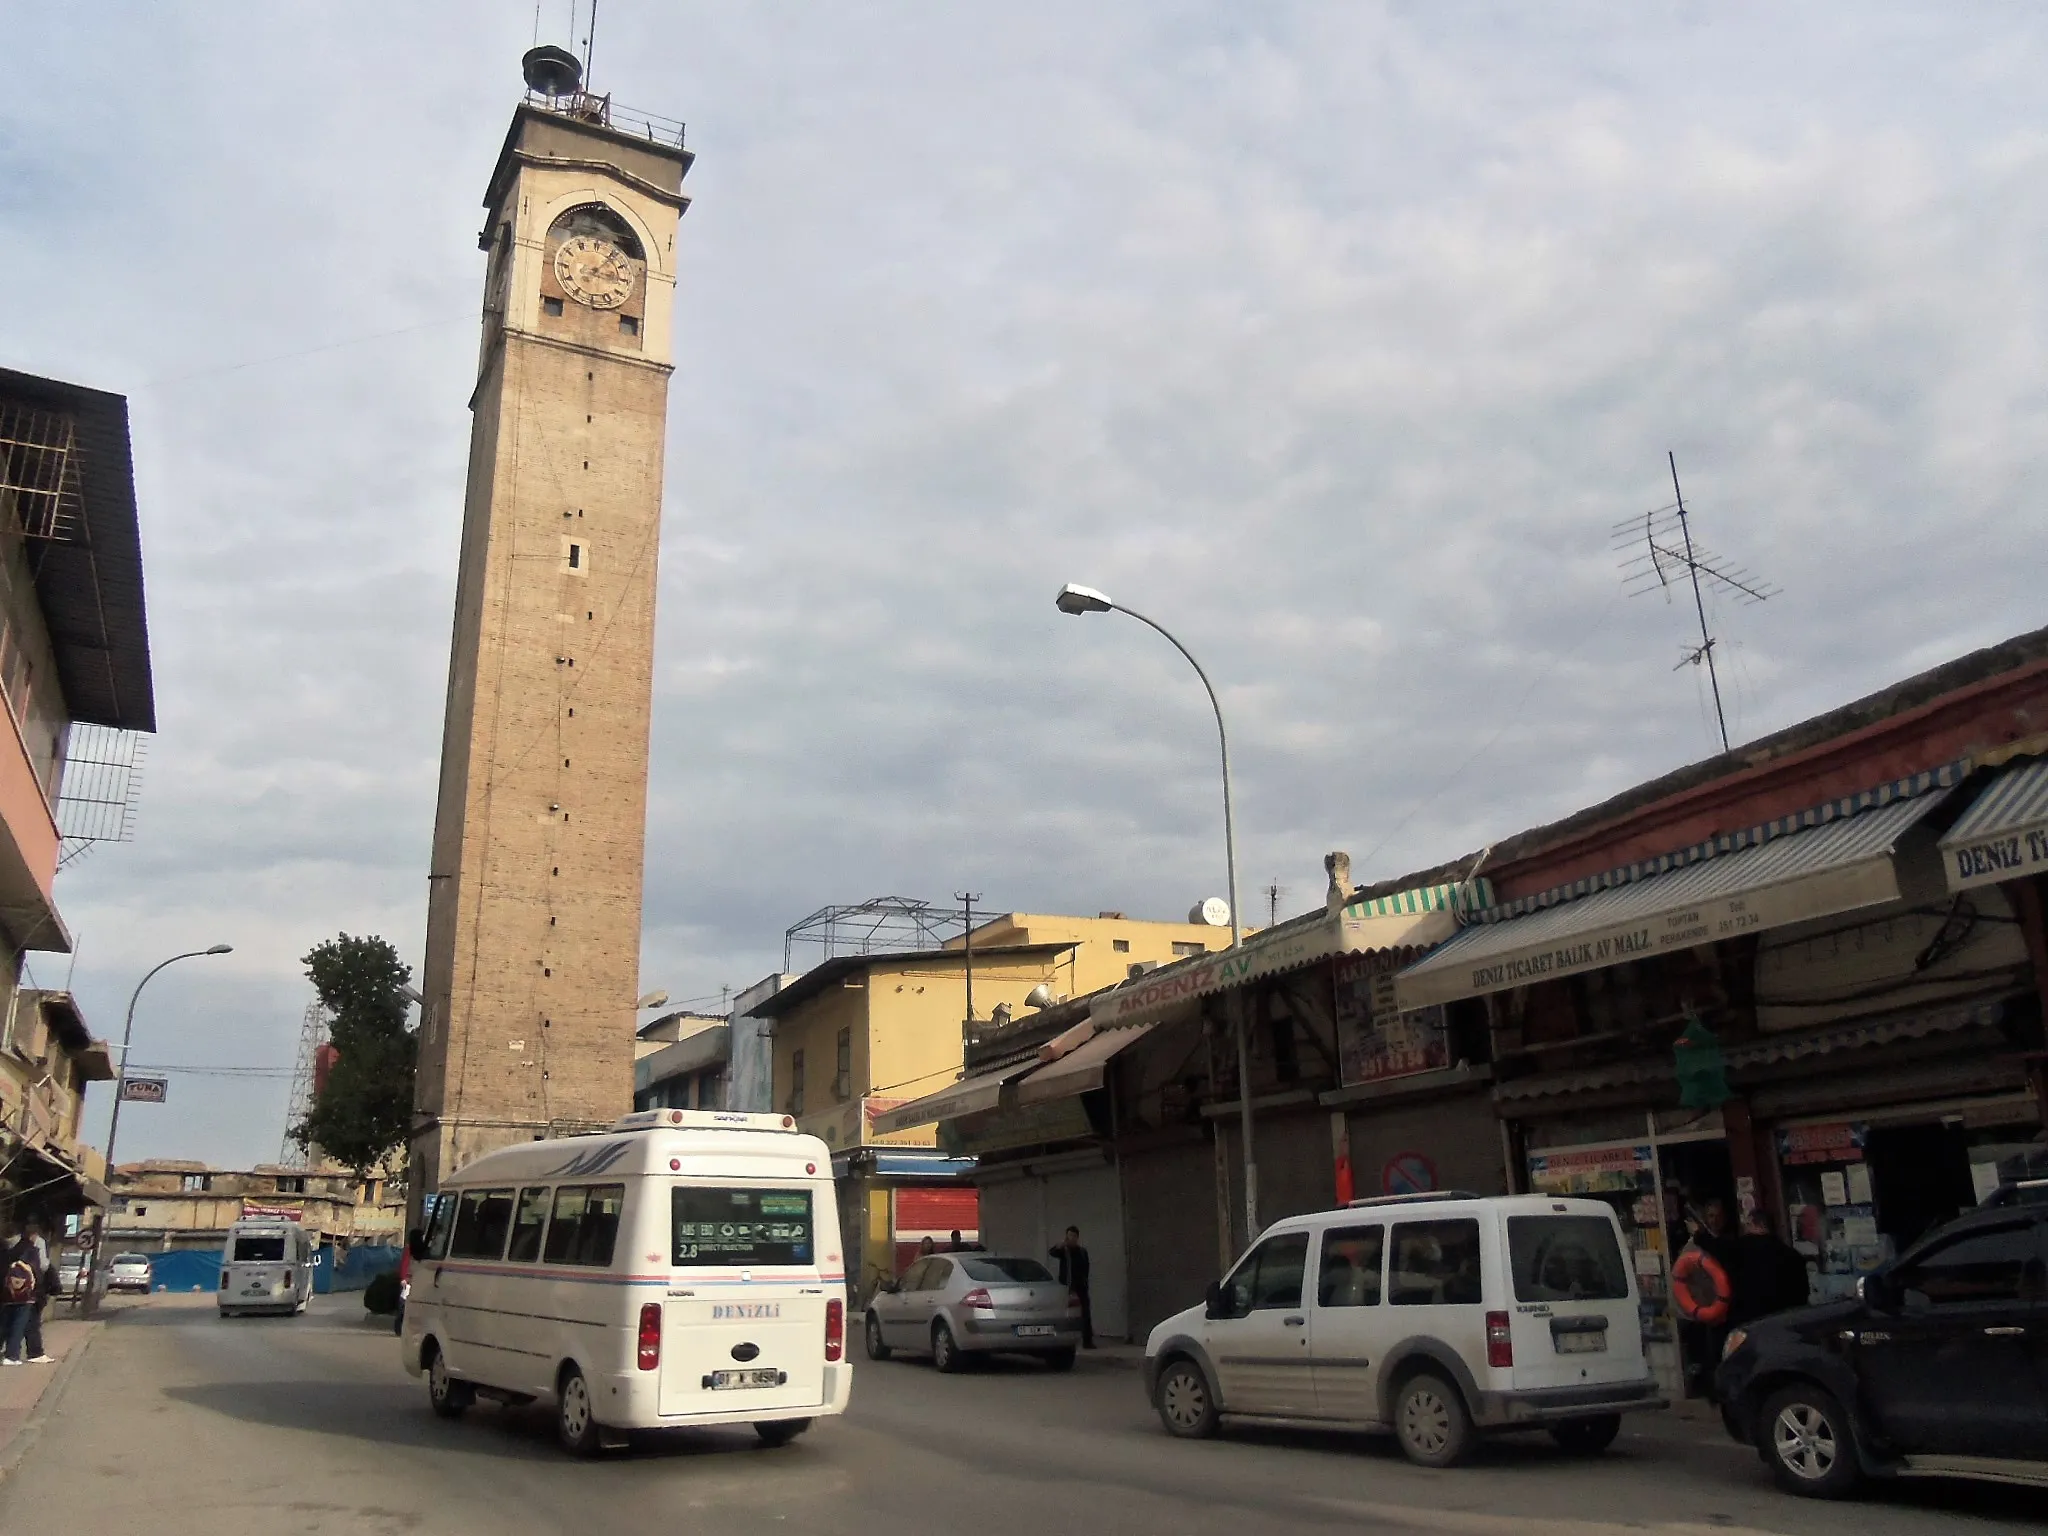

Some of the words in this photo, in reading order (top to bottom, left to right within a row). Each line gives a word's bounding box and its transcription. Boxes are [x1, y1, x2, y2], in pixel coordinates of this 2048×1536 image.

[1595, 938, 1611, 960] AV
[1219, 952, 1252, 982] AV
[678, 1244, 698, 1259] 2.8
